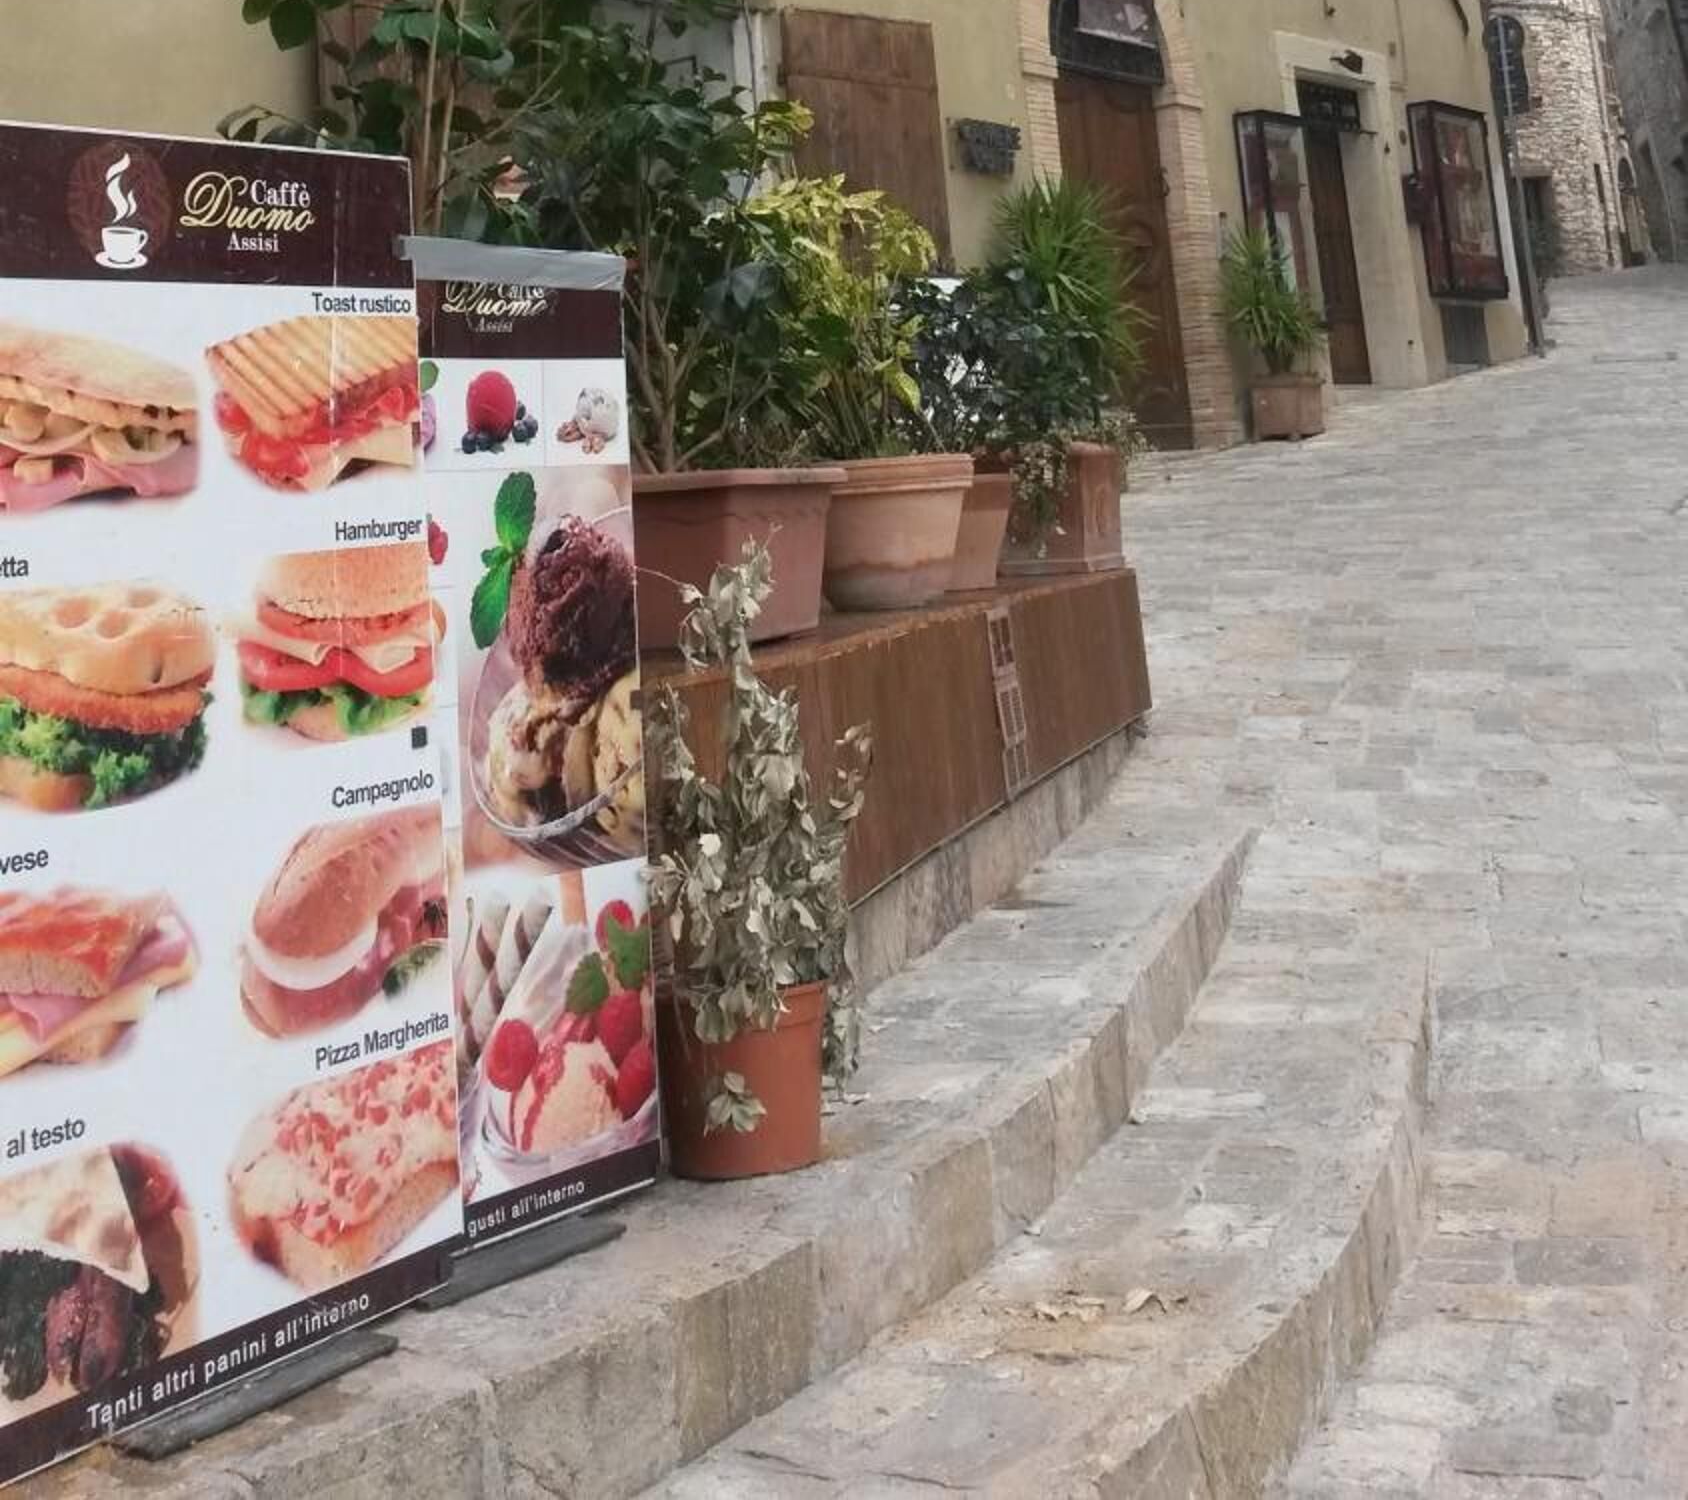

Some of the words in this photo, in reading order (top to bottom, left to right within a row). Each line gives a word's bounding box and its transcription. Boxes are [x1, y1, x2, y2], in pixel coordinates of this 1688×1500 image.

[179, 171, 316, 232] Duomo
[250, 179, 311, 208] Caffè
[227, 232, 279, 252] Assisi
[312, 291, 357, 313] Toast
[360, 294, 411, 313] rustico
[335, 518, 422, 541] Hamburger
[332, 768, 434, 808] Campagnolo
[315, 1041, 360, 1070] Pizza
[363, 1012, 449, 1055] Margherita
[7, 1129, 25, 1158] al
[31, 1118, 85, 1151] testo
[467, 1205, 506, 1238] gusti
[511, 1181, 585, 1218] all'interno
[86, 1386, 144, 1430] Tanti
[152, 1363, 195, 1401] altri
[203, 1332, 267, 1384] panini
[274, 1293, 370, 1349] all'interno
